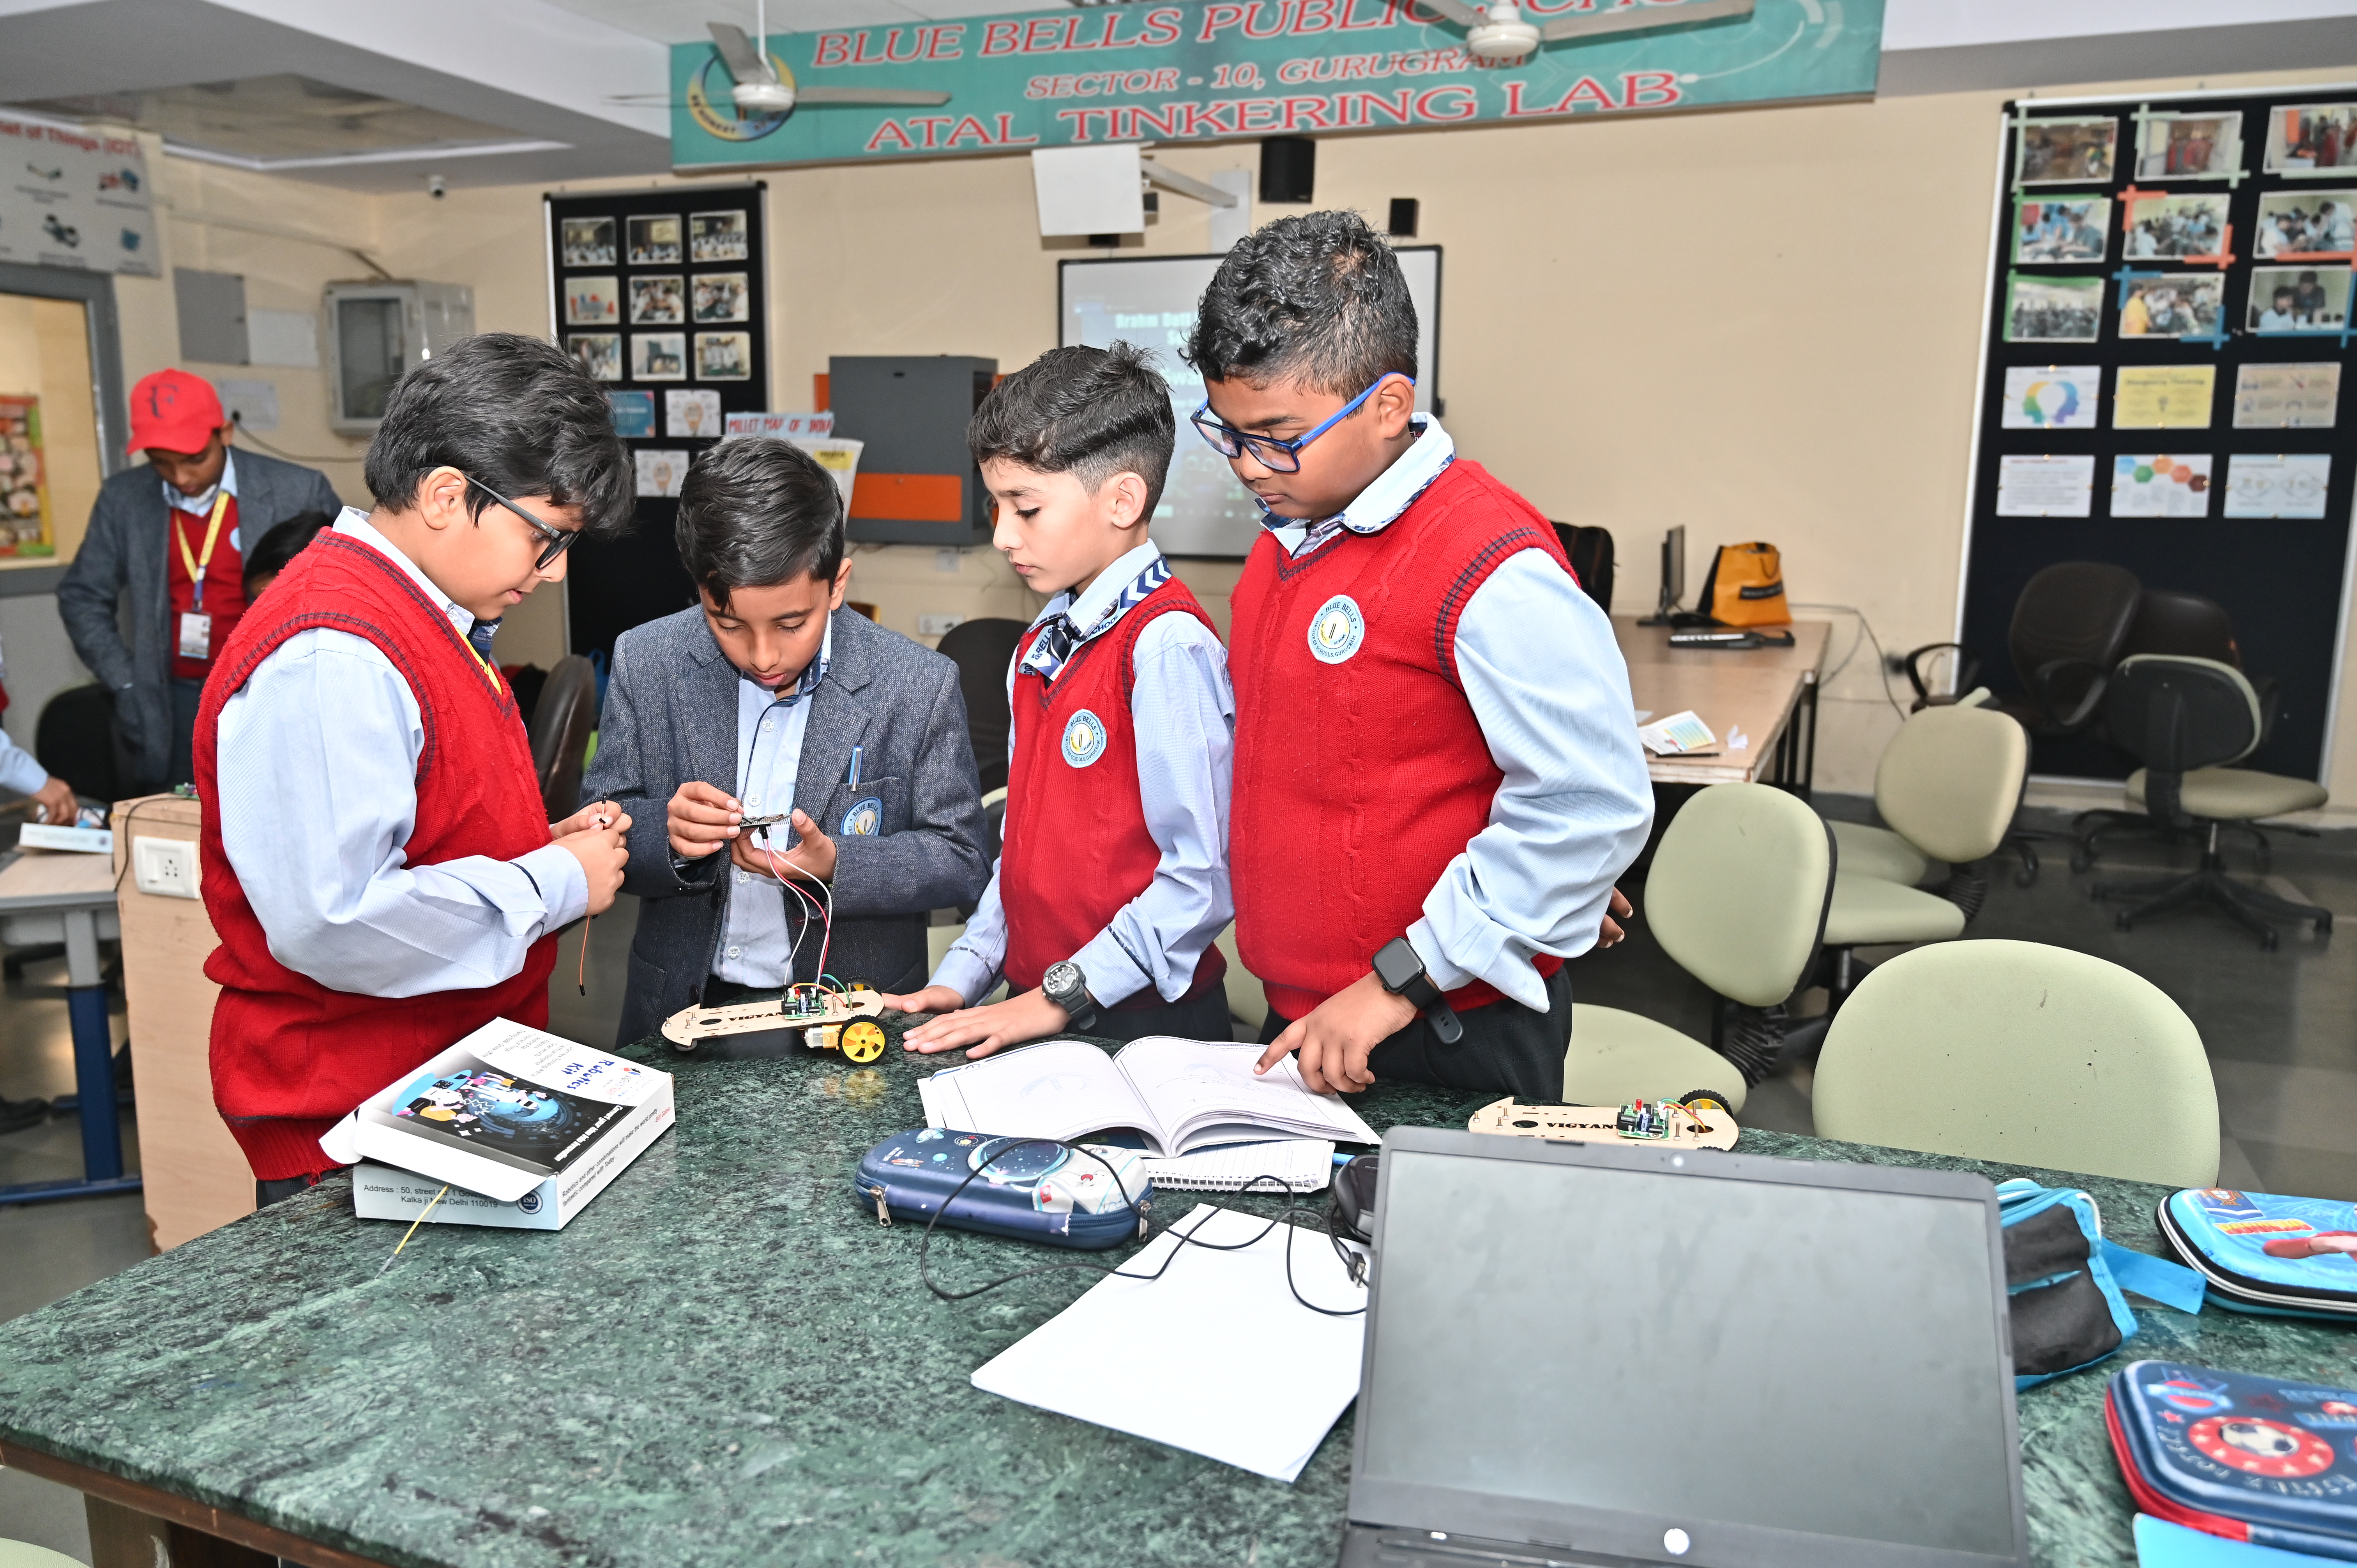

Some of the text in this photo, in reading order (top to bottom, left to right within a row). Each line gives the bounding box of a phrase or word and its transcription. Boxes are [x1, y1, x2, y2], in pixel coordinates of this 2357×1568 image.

[813, 25, 965, 66] BLUE
[979, 9, 1180, 57] BELLS
[1026, 68, 1180, 98] SECTOR
[1211, 63, 1264, 88] 10,
[866, 72, 1681, 150] ATAL TINKERING LAB
[1325, 602, 1357, 623] BLUE BELLS
[1335, 635, 1357, 657] GURUGRAM
[1070, 715, 1097, 730] BLUE BELLS
[1086, 740, 1101, 760] GURUGRAM
[852, 802, 878, 817] BLUE BELLS
[559, 1062, 584, 1075] Kit
[565, 1058, 615, 1091] Robotics
[602, 1105, 624, 1120] Convert
[583, 1126, 599, 1136] idea
[590, 1117, 608, 1128] your
[574, 1134, 590, 1143] into
[563, 1180, 578, 1197] Robotics
[587, 1164, 595, 1175] other
[596, 1143, 618, 1166] combinations
[625, 1129, 634, 1140] make
[640, 1116, 648, 1127] world
[649, 1107, 657, 1119] pretty
[364, 1185, 394, 1193] Address
[563, 1189, 578, 1206] fantastic
[579, 1172, 596, 1192] compared
[424, 1197, 428, 1205] ji
[471, 1200, 498, 1208] 110019
[2215, 1218, 2314, 1235] RONALDO
